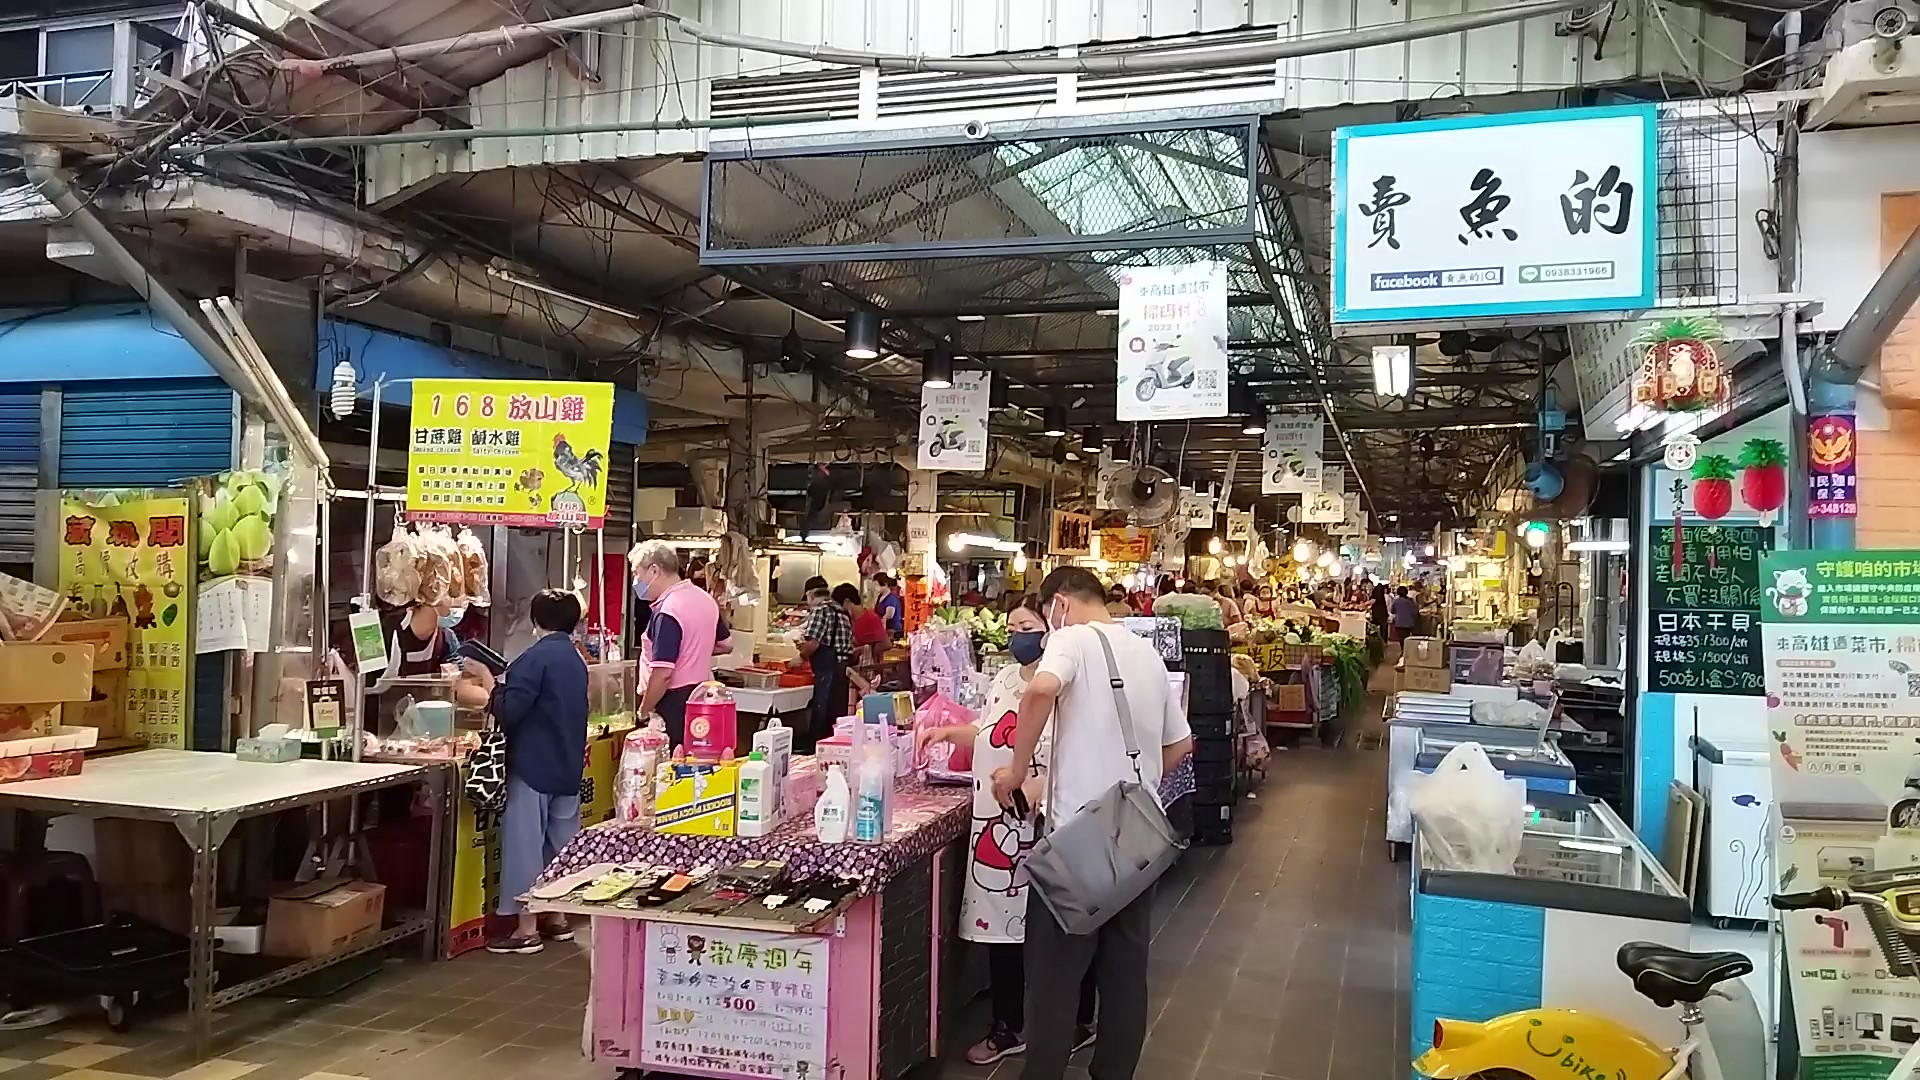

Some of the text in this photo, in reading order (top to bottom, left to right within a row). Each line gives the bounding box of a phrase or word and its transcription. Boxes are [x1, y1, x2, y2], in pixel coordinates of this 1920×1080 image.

[1358, 165, 1633, 250] 賣魚的
[1374, 273, 1439, 289] facebook
[508, 395, 585, 421] 放山雞
[415, 428, 462, 445] 甘蔗雞
[559, 502, 579, 512] 168
[547, 511, 589, 522] 放山雞
[1658, 612, 1750, 632] 日本干貝
[708, 940, 813, 976] 歡慶週年
[722, 996, 756, 1012] 500
